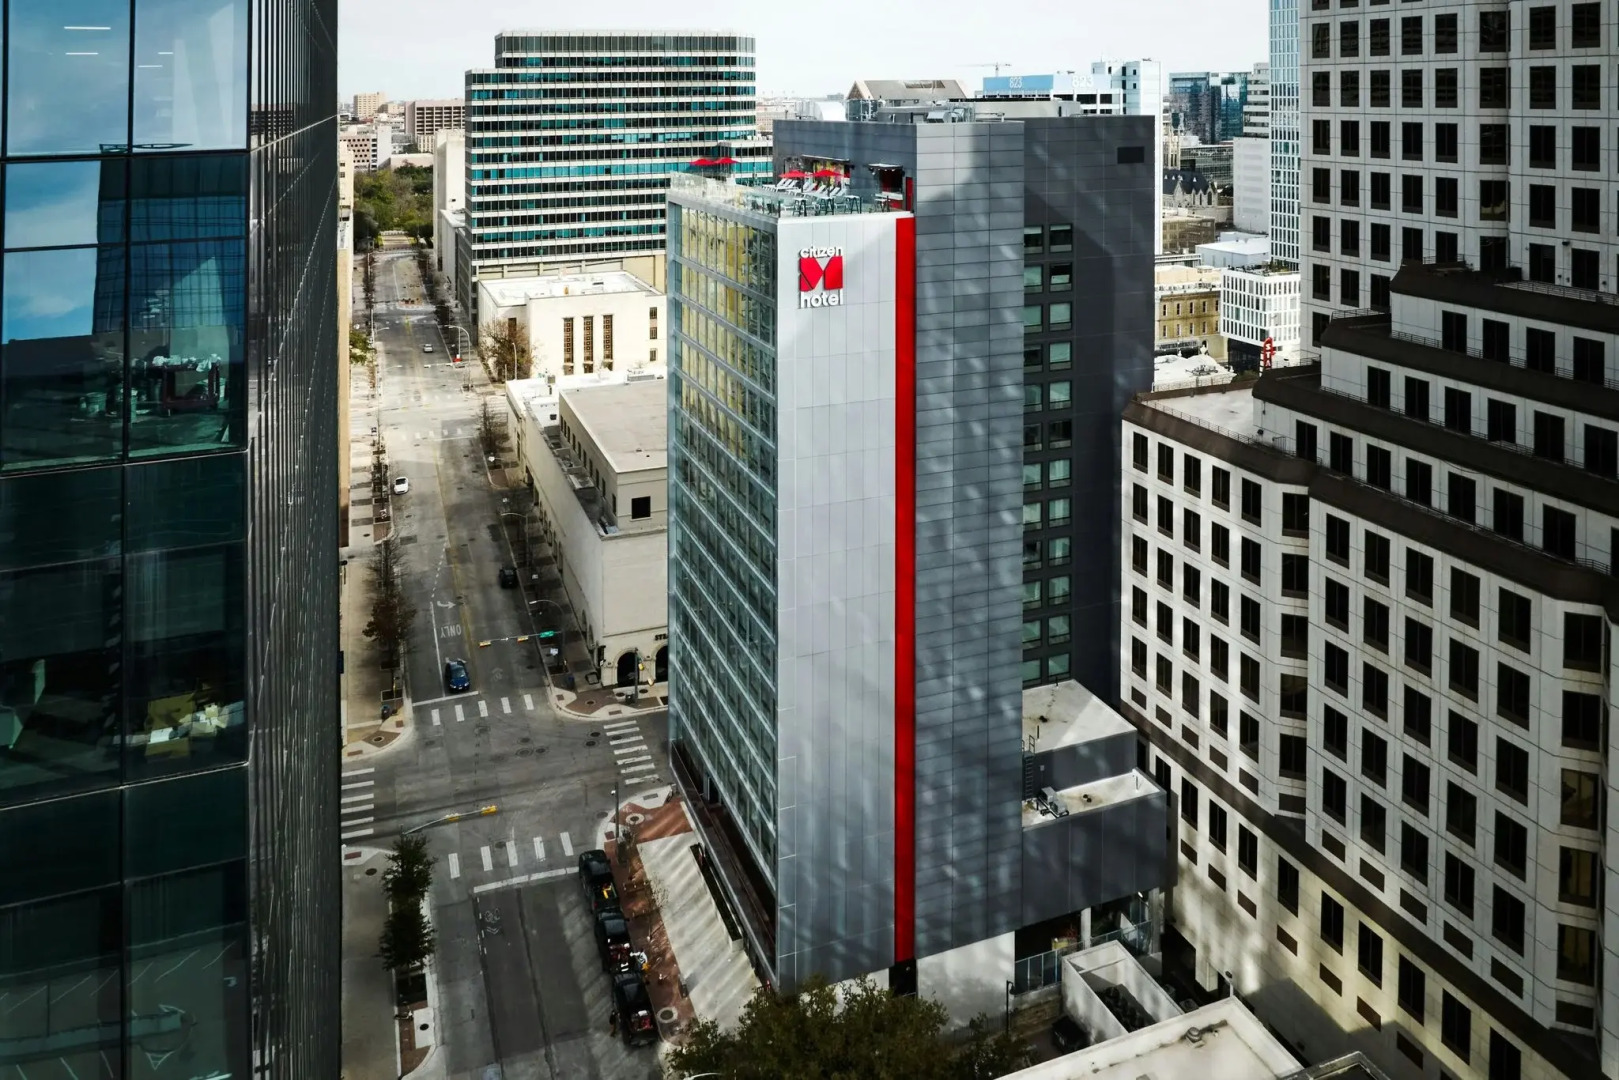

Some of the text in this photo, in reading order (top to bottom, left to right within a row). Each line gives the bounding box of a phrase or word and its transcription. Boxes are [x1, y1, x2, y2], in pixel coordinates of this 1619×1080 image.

[1009, 76, 1022, 88] 823
[1072, 75, 1094, 88] 823
[799, 245, 842, 258] citizen
[799, 291, 843, 308] hotel
[440, 624, 462, 639] ONLY
